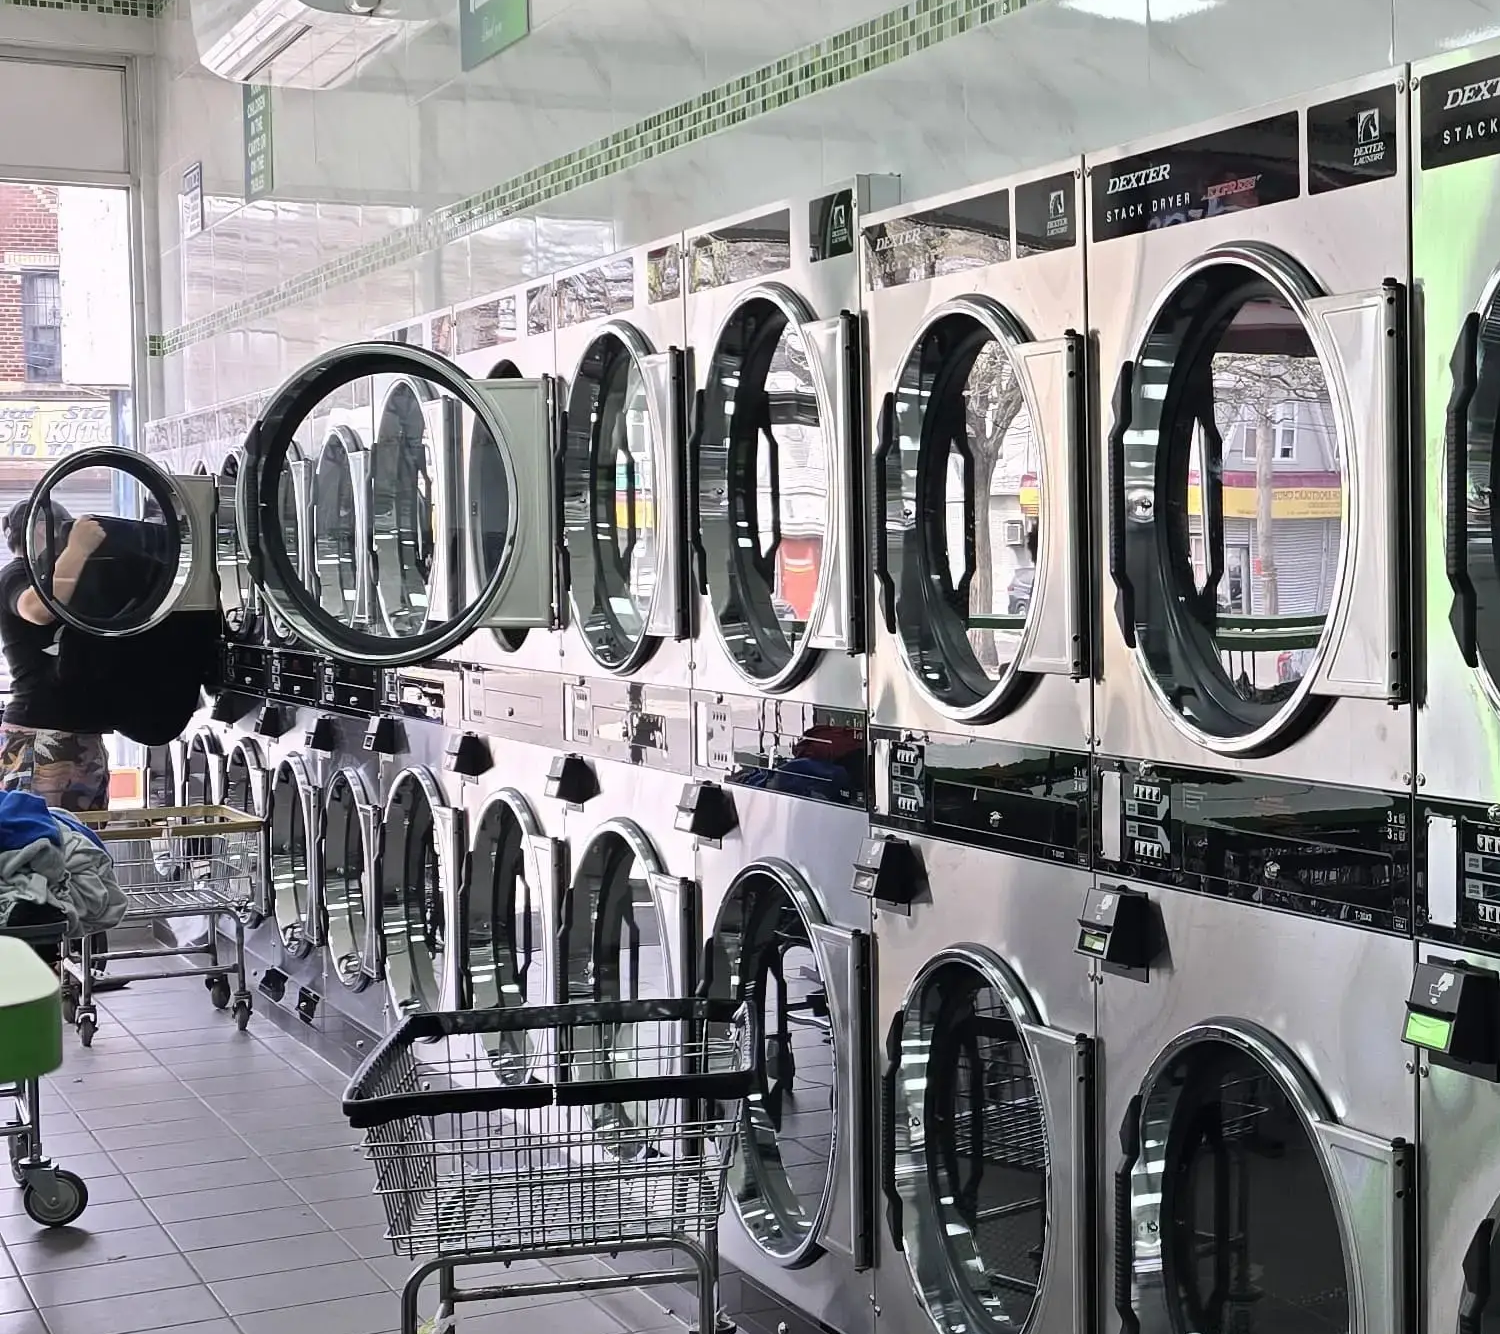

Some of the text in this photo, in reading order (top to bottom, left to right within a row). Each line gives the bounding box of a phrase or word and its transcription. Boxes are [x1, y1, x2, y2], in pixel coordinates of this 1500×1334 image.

[1443, 118, 1498, 145] STACK
[1353, 141, 1384, 157] DEXTER
[1106, 163, 1171, 195] DEXTER
[1106, 192, 1190, 223] STACK DRYER
[875, 228, 921, 252] DEXTER
[1387, 810, 1393, 823] 3
